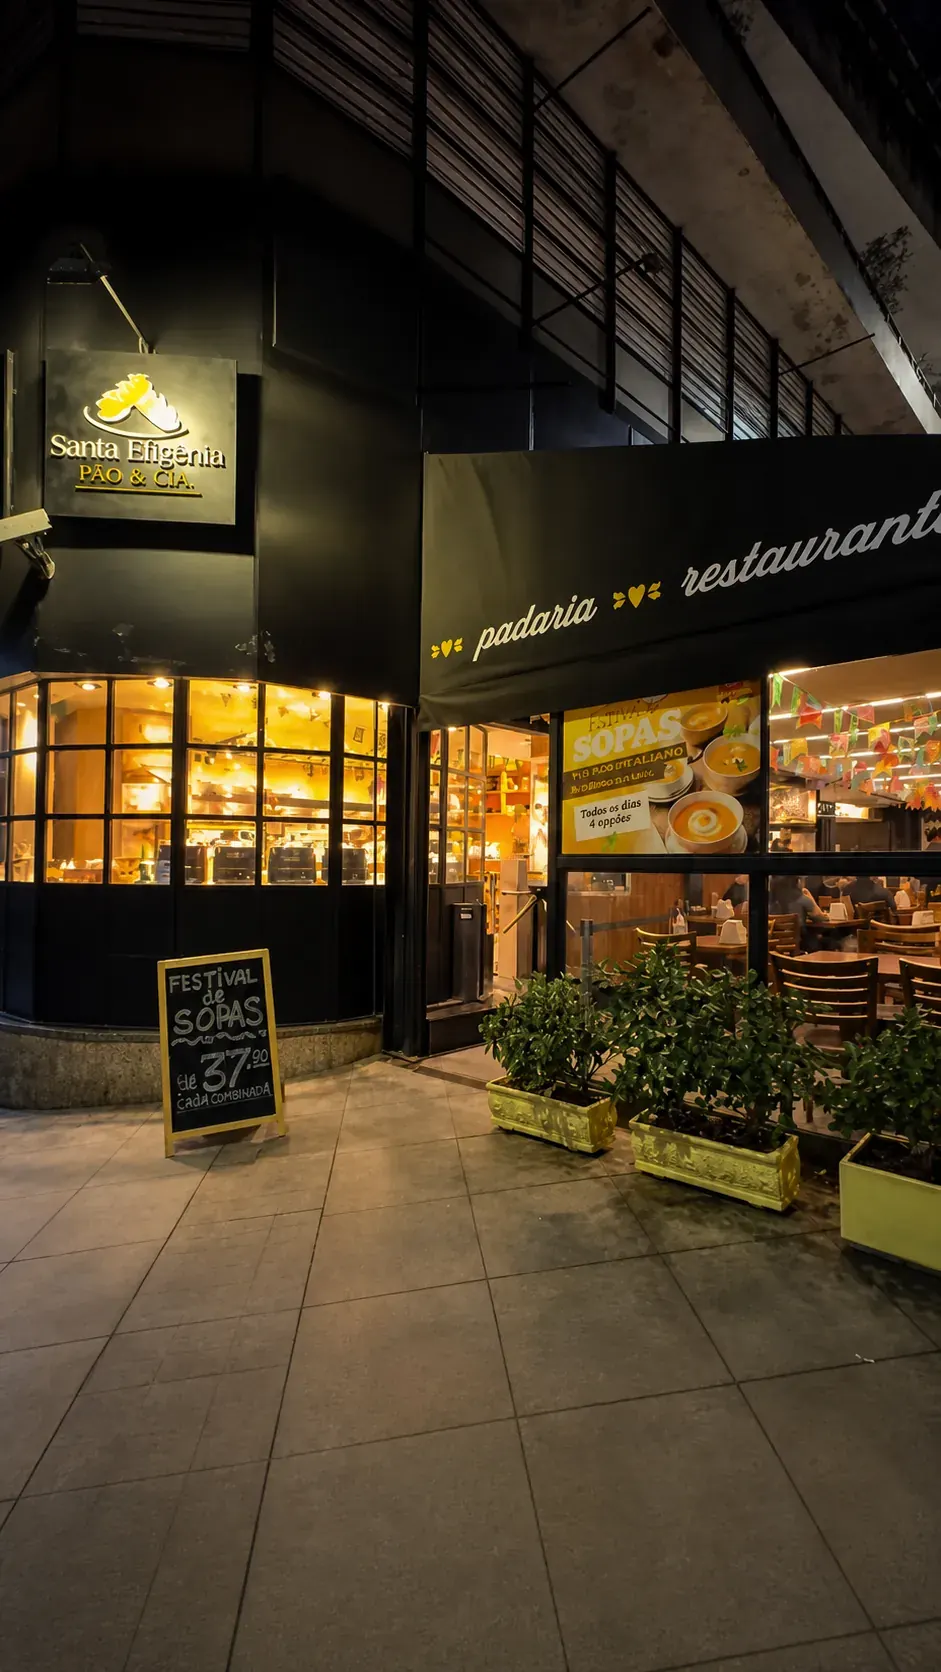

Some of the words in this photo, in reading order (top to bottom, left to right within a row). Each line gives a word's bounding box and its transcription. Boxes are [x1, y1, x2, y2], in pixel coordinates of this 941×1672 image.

[50, 435, 119, 461] Santa
[127, 440, 226, 469] Efigênia
[79, 463, 122, 484] PÃO
[129, 468, 146, 485] &
[153, 470, 195, 489] CIA.
[472, 594, 599, 662] padaria
[573, 708, 681, 763] SOPAS
[580, 806, 607, 819] Todos
[609, 804, 619, 813] os
[621, 799, 642, 811] dias
[589, 818, 596, 829] 4
[202, 988, 226, 1006] de
[172, 995, 264, 1035] SOPAS
[177, 1073, 198, 1091] de
[210, 1081, 273, 1105] COMBINADA
